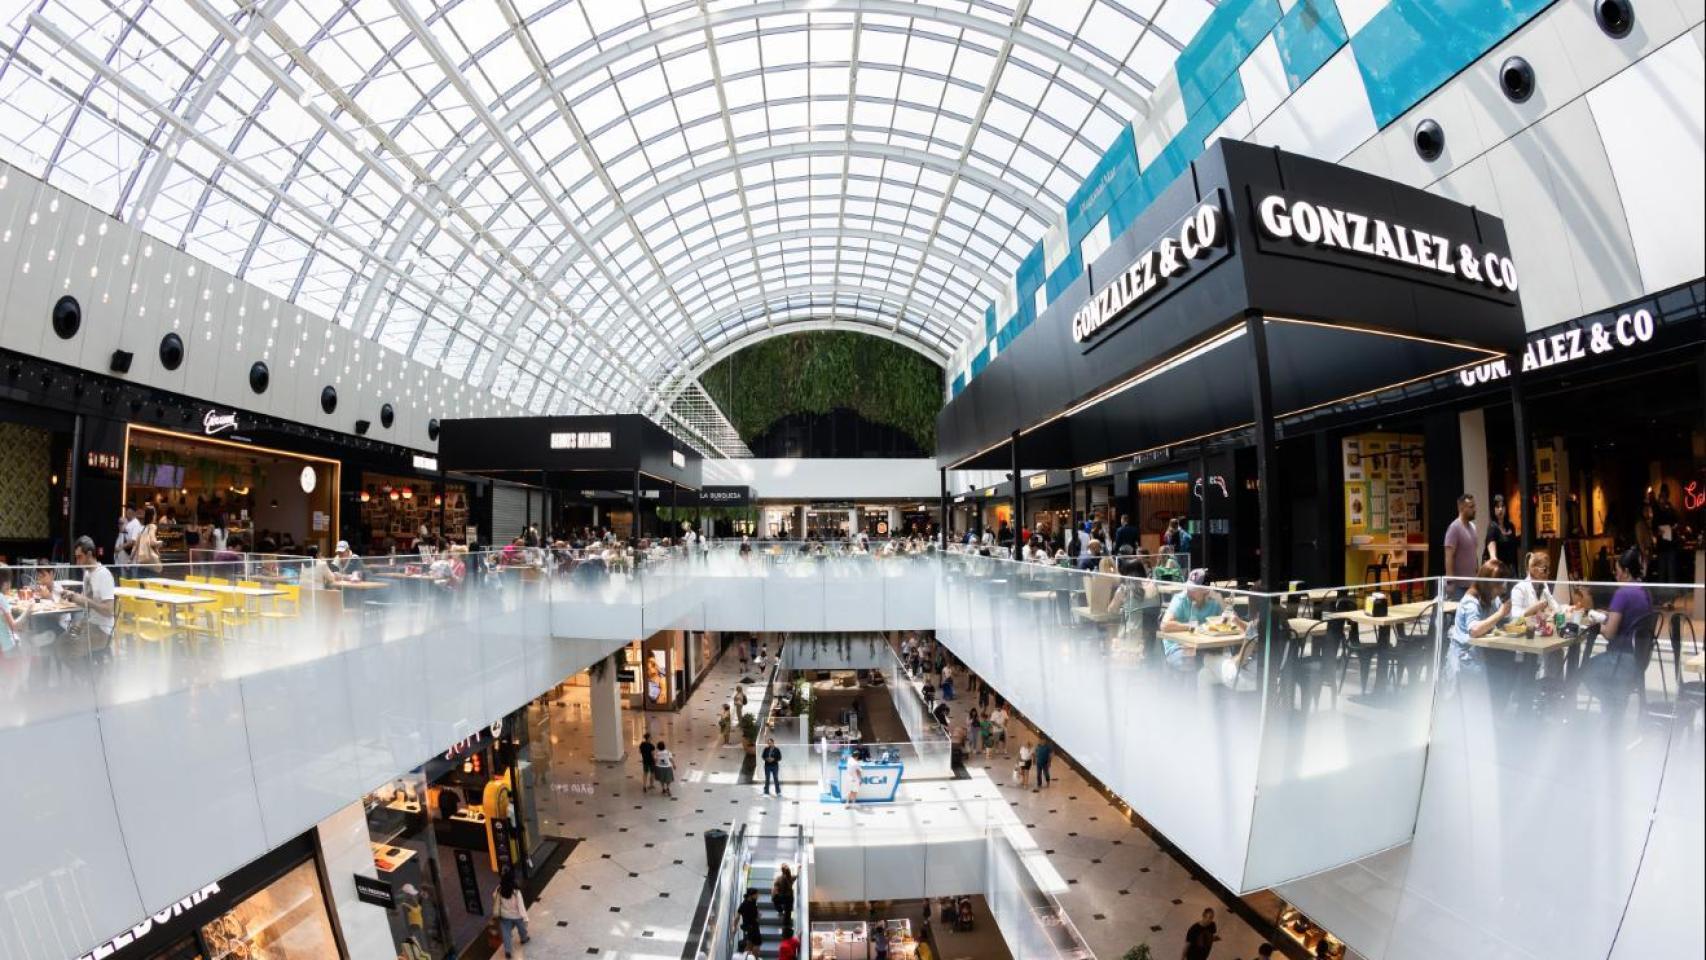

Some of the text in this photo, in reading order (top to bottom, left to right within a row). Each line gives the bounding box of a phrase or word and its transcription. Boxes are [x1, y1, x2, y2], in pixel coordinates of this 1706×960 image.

[1073, 204, 1219, 343] GONZALEZ & CO
[1258, 195, 1518, 292] GONZALEZ & CO
[1460, 309, 1654, 387] GONALEZ & CO
